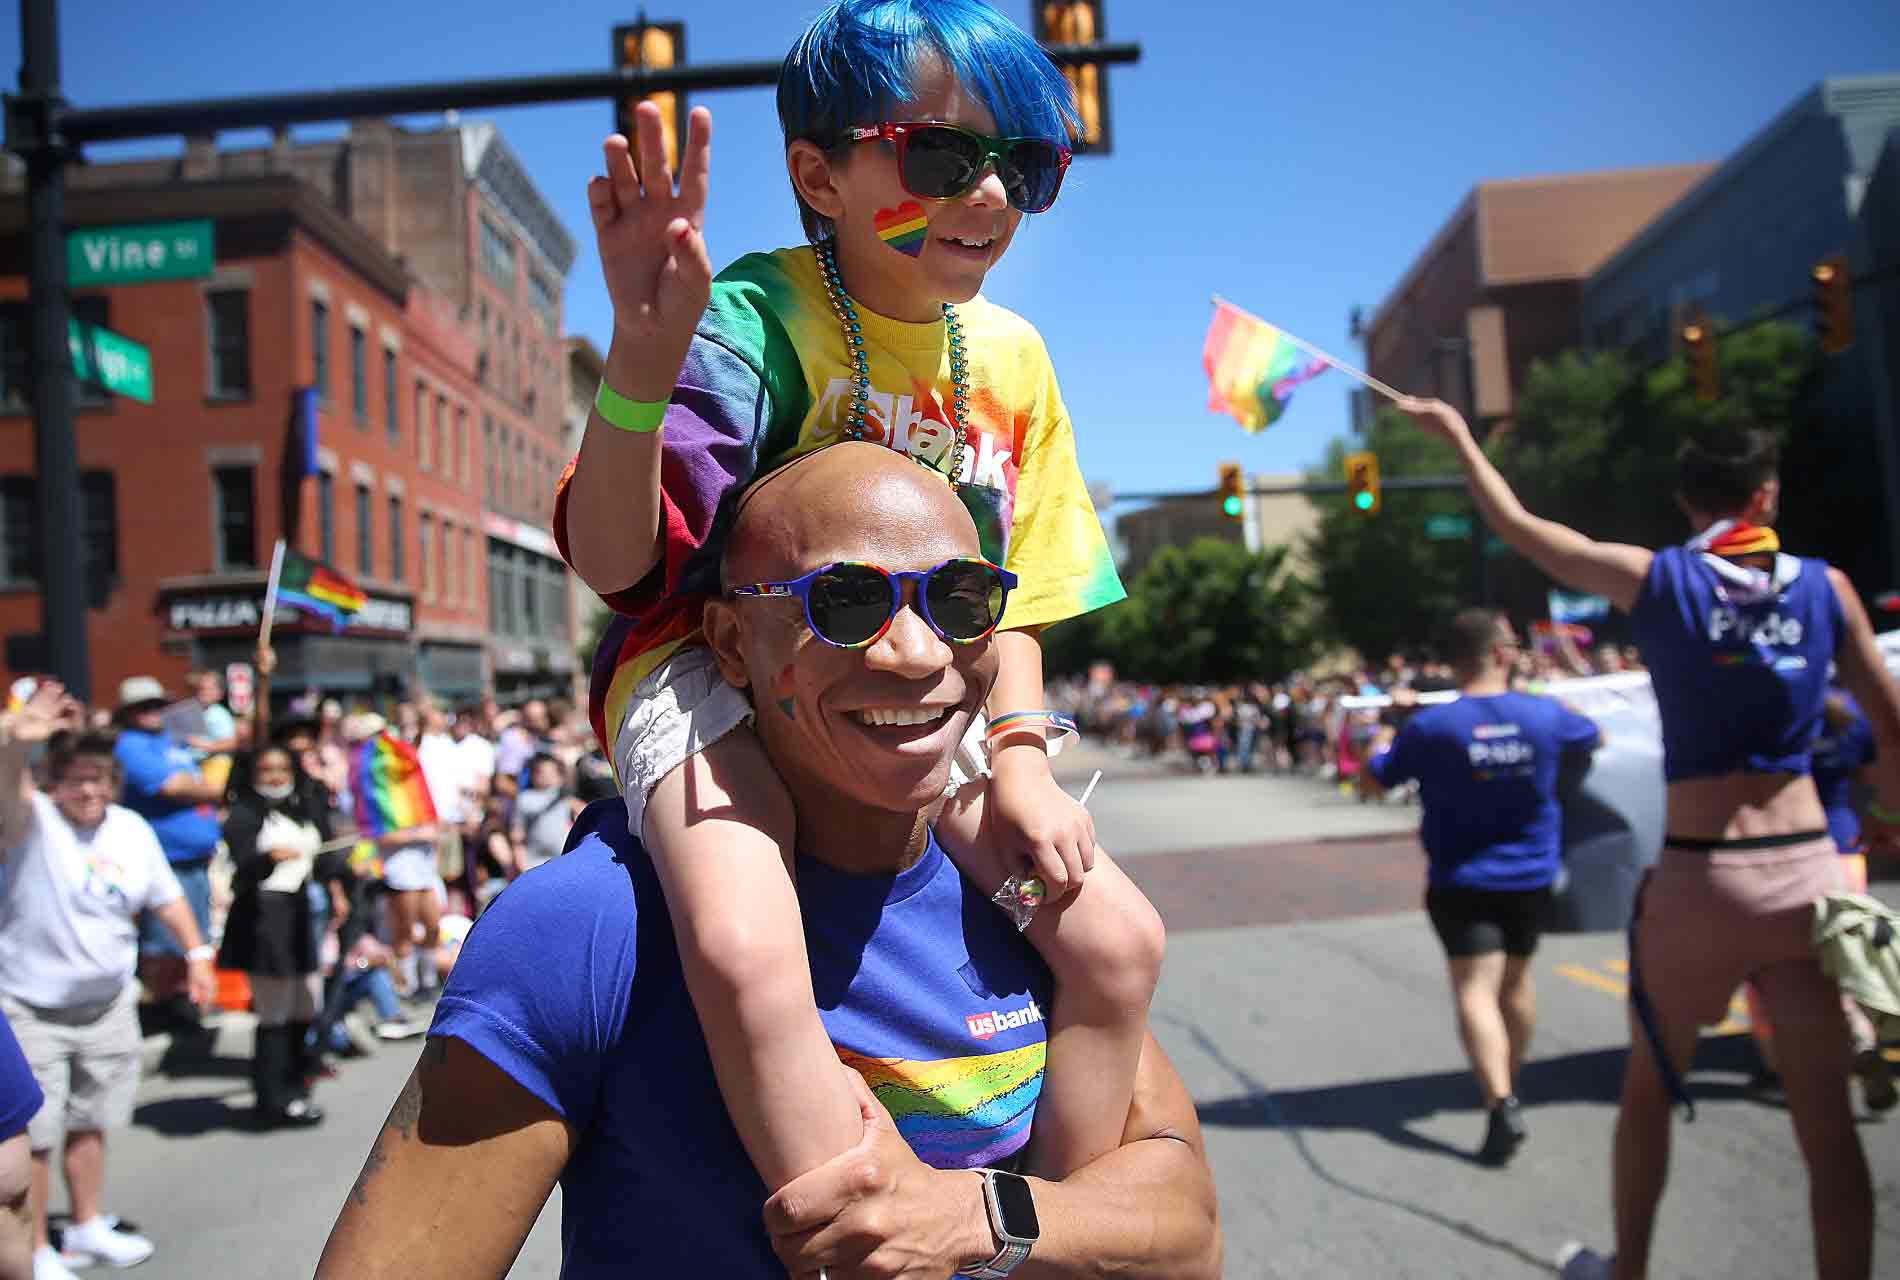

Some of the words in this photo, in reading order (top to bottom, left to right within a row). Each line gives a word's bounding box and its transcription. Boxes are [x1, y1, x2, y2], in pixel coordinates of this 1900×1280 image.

[82, 235, 165, 272] Vine
[1710, 607, 1803, 646] Prde
[967, 1000, 1043, 1037] usbank
